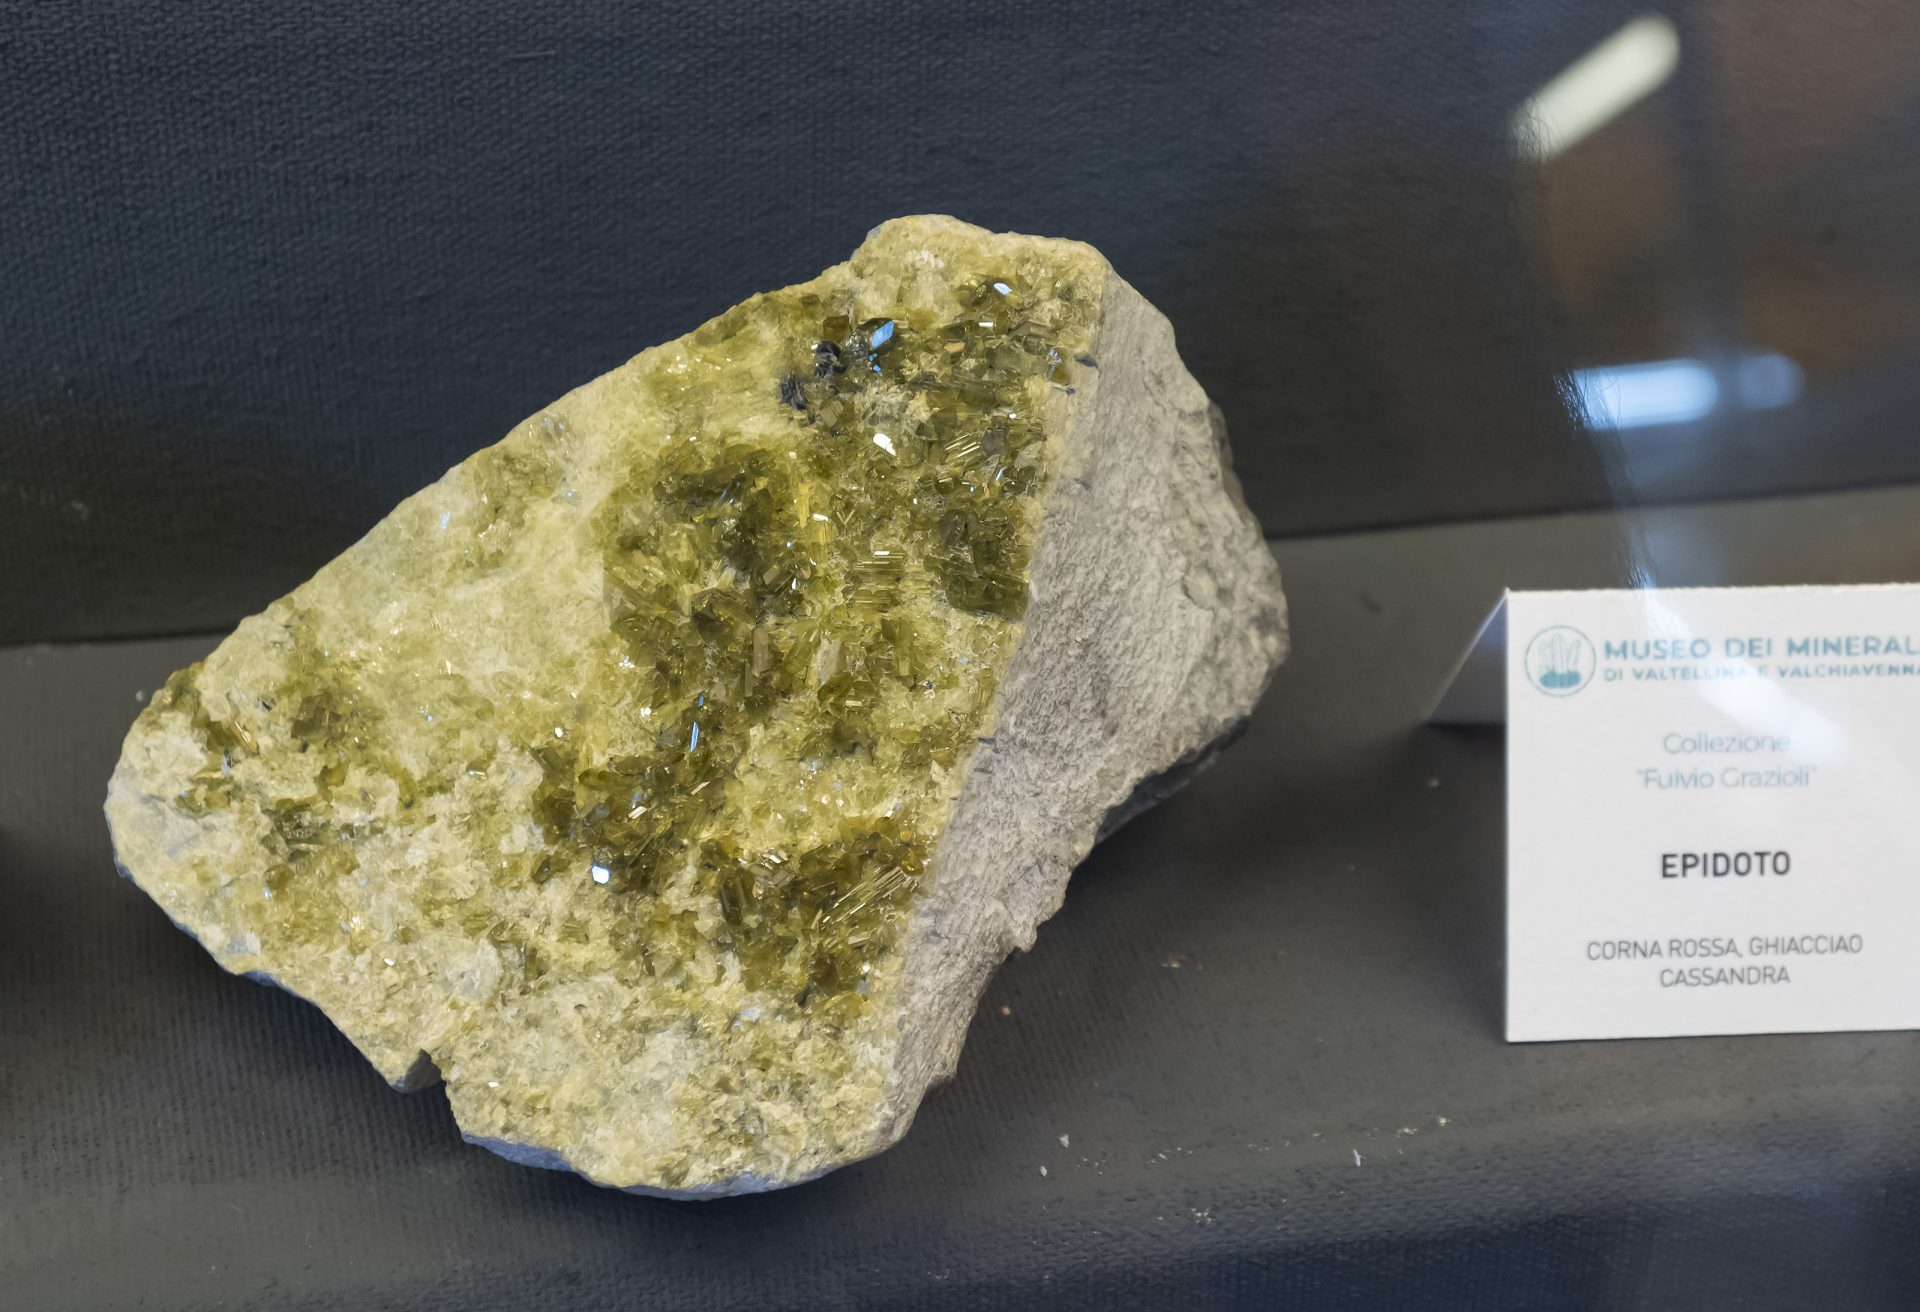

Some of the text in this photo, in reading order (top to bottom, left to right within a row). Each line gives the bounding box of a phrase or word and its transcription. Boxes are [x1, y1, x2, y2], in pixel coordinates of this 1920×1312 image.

[1604, 638, 1711, 660] MUSEO
[1725, 637, 1772, 658] DEI
[1604, 668, 1623, 681] DI
[1758, 666, 1768, 677] E
[1663, 732, 1790, 754] Collezione
[1661, 851, 1791, 879] EPIDOTO
[1587, 934, 1863, 960] CORNA ROSSA, GHIACCIAO
[1660, 966, 1790, 987] CASSANDRA
